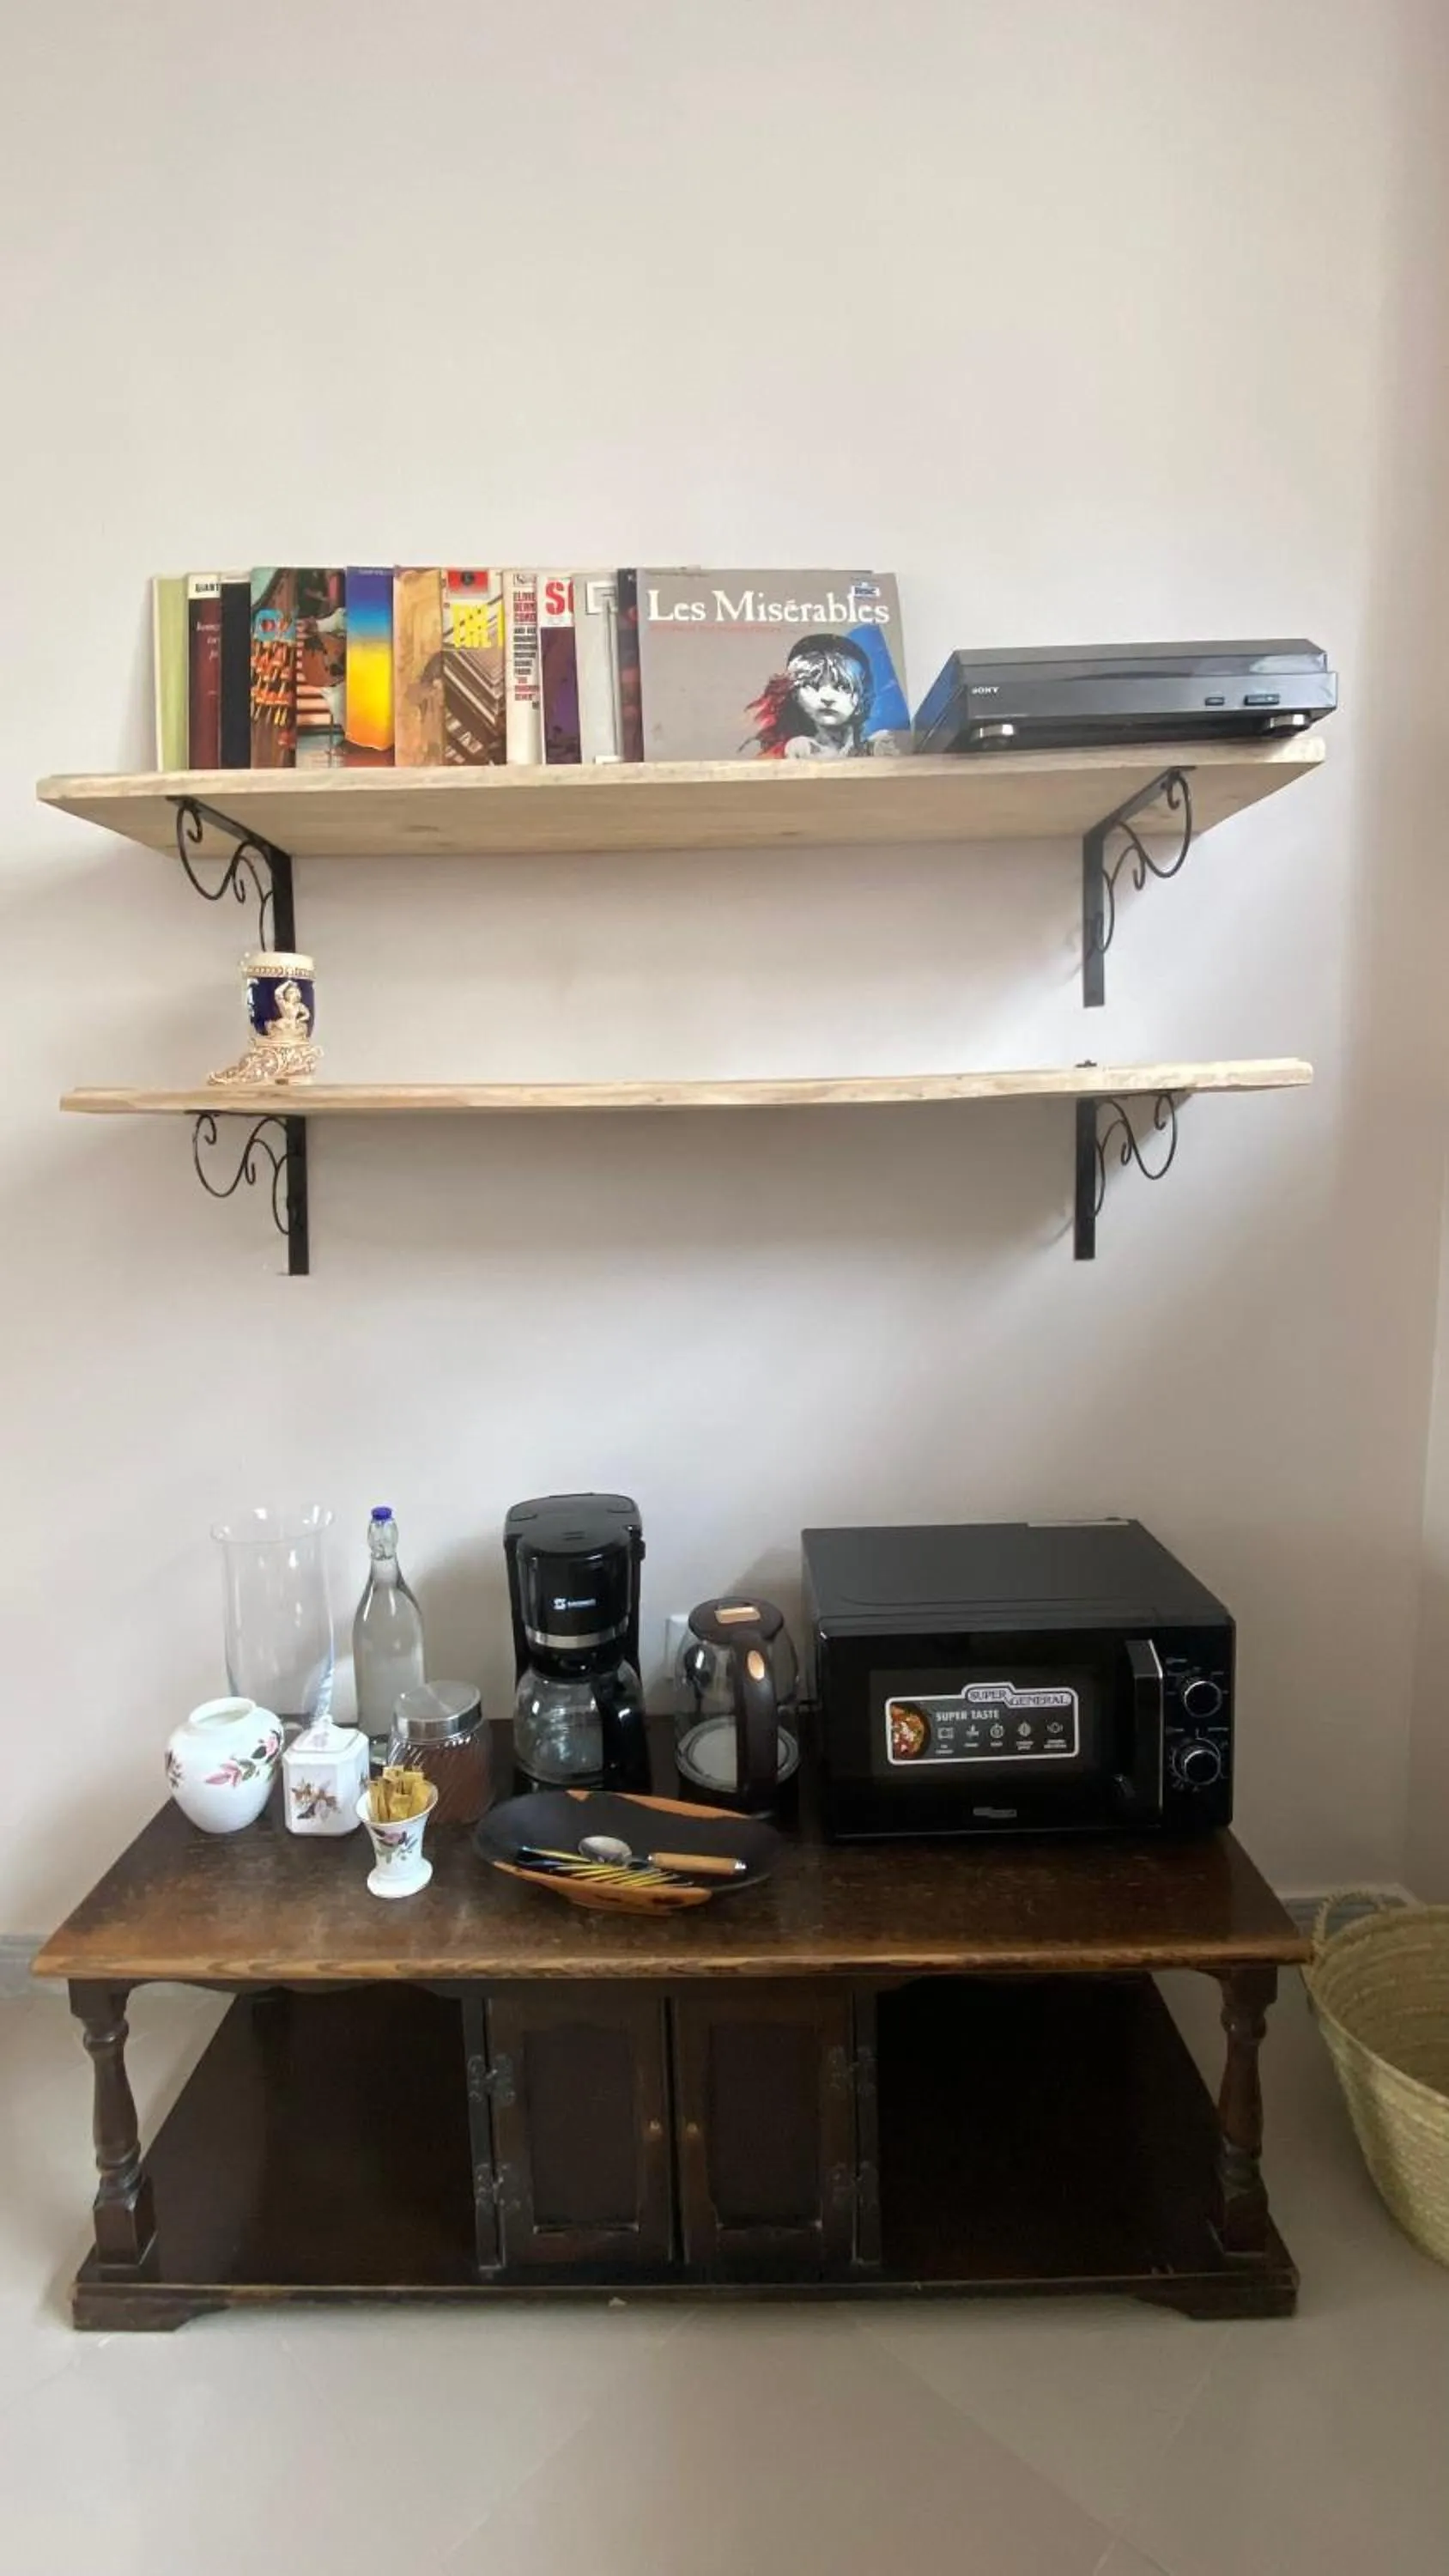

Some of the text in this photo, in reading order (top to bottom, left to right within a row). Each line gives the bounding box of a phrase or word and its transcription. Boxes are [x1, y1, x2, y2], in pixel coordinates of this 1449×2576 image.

[647, 589, 890, 623] Les Misérables
[971, 686, 1000, 695] SONY
[969, 1689, 1069, 1705] SUPER GENERAL
[936, 1709, 1000, 1722] SUPER TASTE
